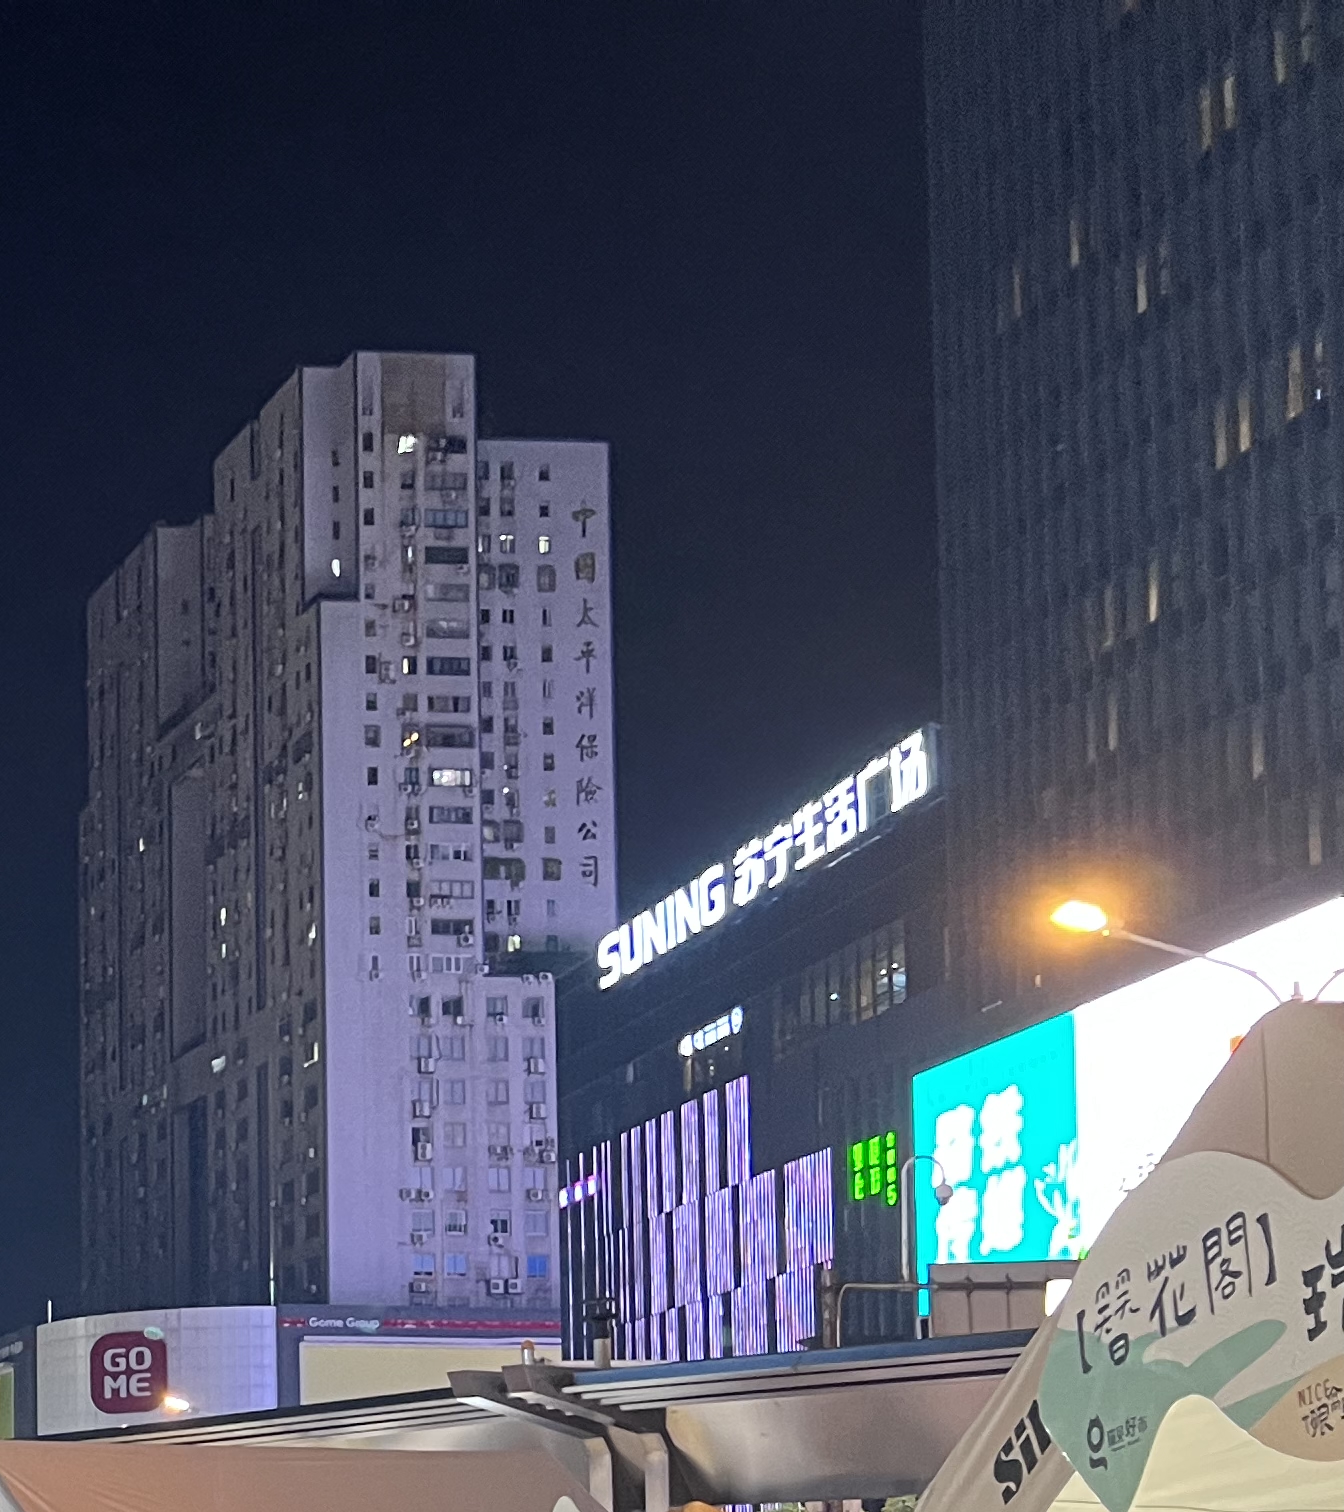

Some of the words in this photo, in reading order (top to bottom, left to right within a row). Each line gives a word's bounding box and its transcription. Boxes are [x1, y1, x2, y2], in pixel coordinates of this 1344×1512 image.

[597, 862, 726, 991] SUNING
[732, 728, 929, 907] 苏宁生活广场
[103, 1345, 153, 1373] GO
[103, 1373, 153, 1398] ME
